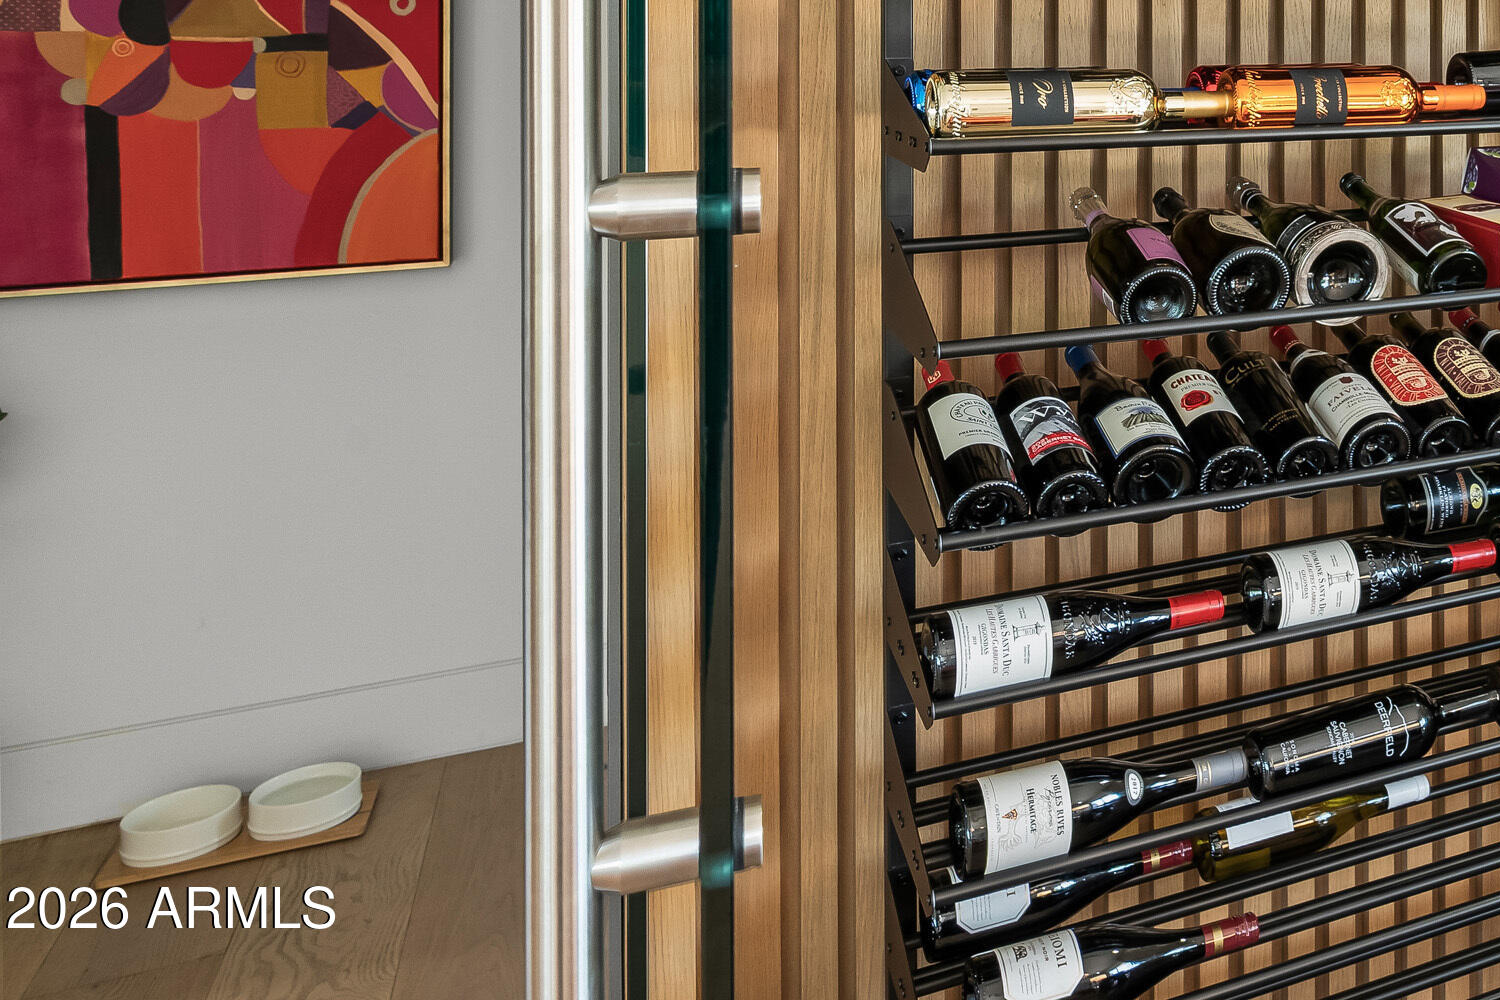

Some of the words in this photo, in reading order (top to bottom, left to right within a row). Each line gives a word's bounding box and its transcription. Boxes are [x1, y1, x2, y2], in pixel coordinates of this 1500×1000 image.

[1050, 773, 1063, 808] NOBLES
[1025, 787, 1037, 834] HERMITAGE
[1055, 808, 1065, 836] RIVES
